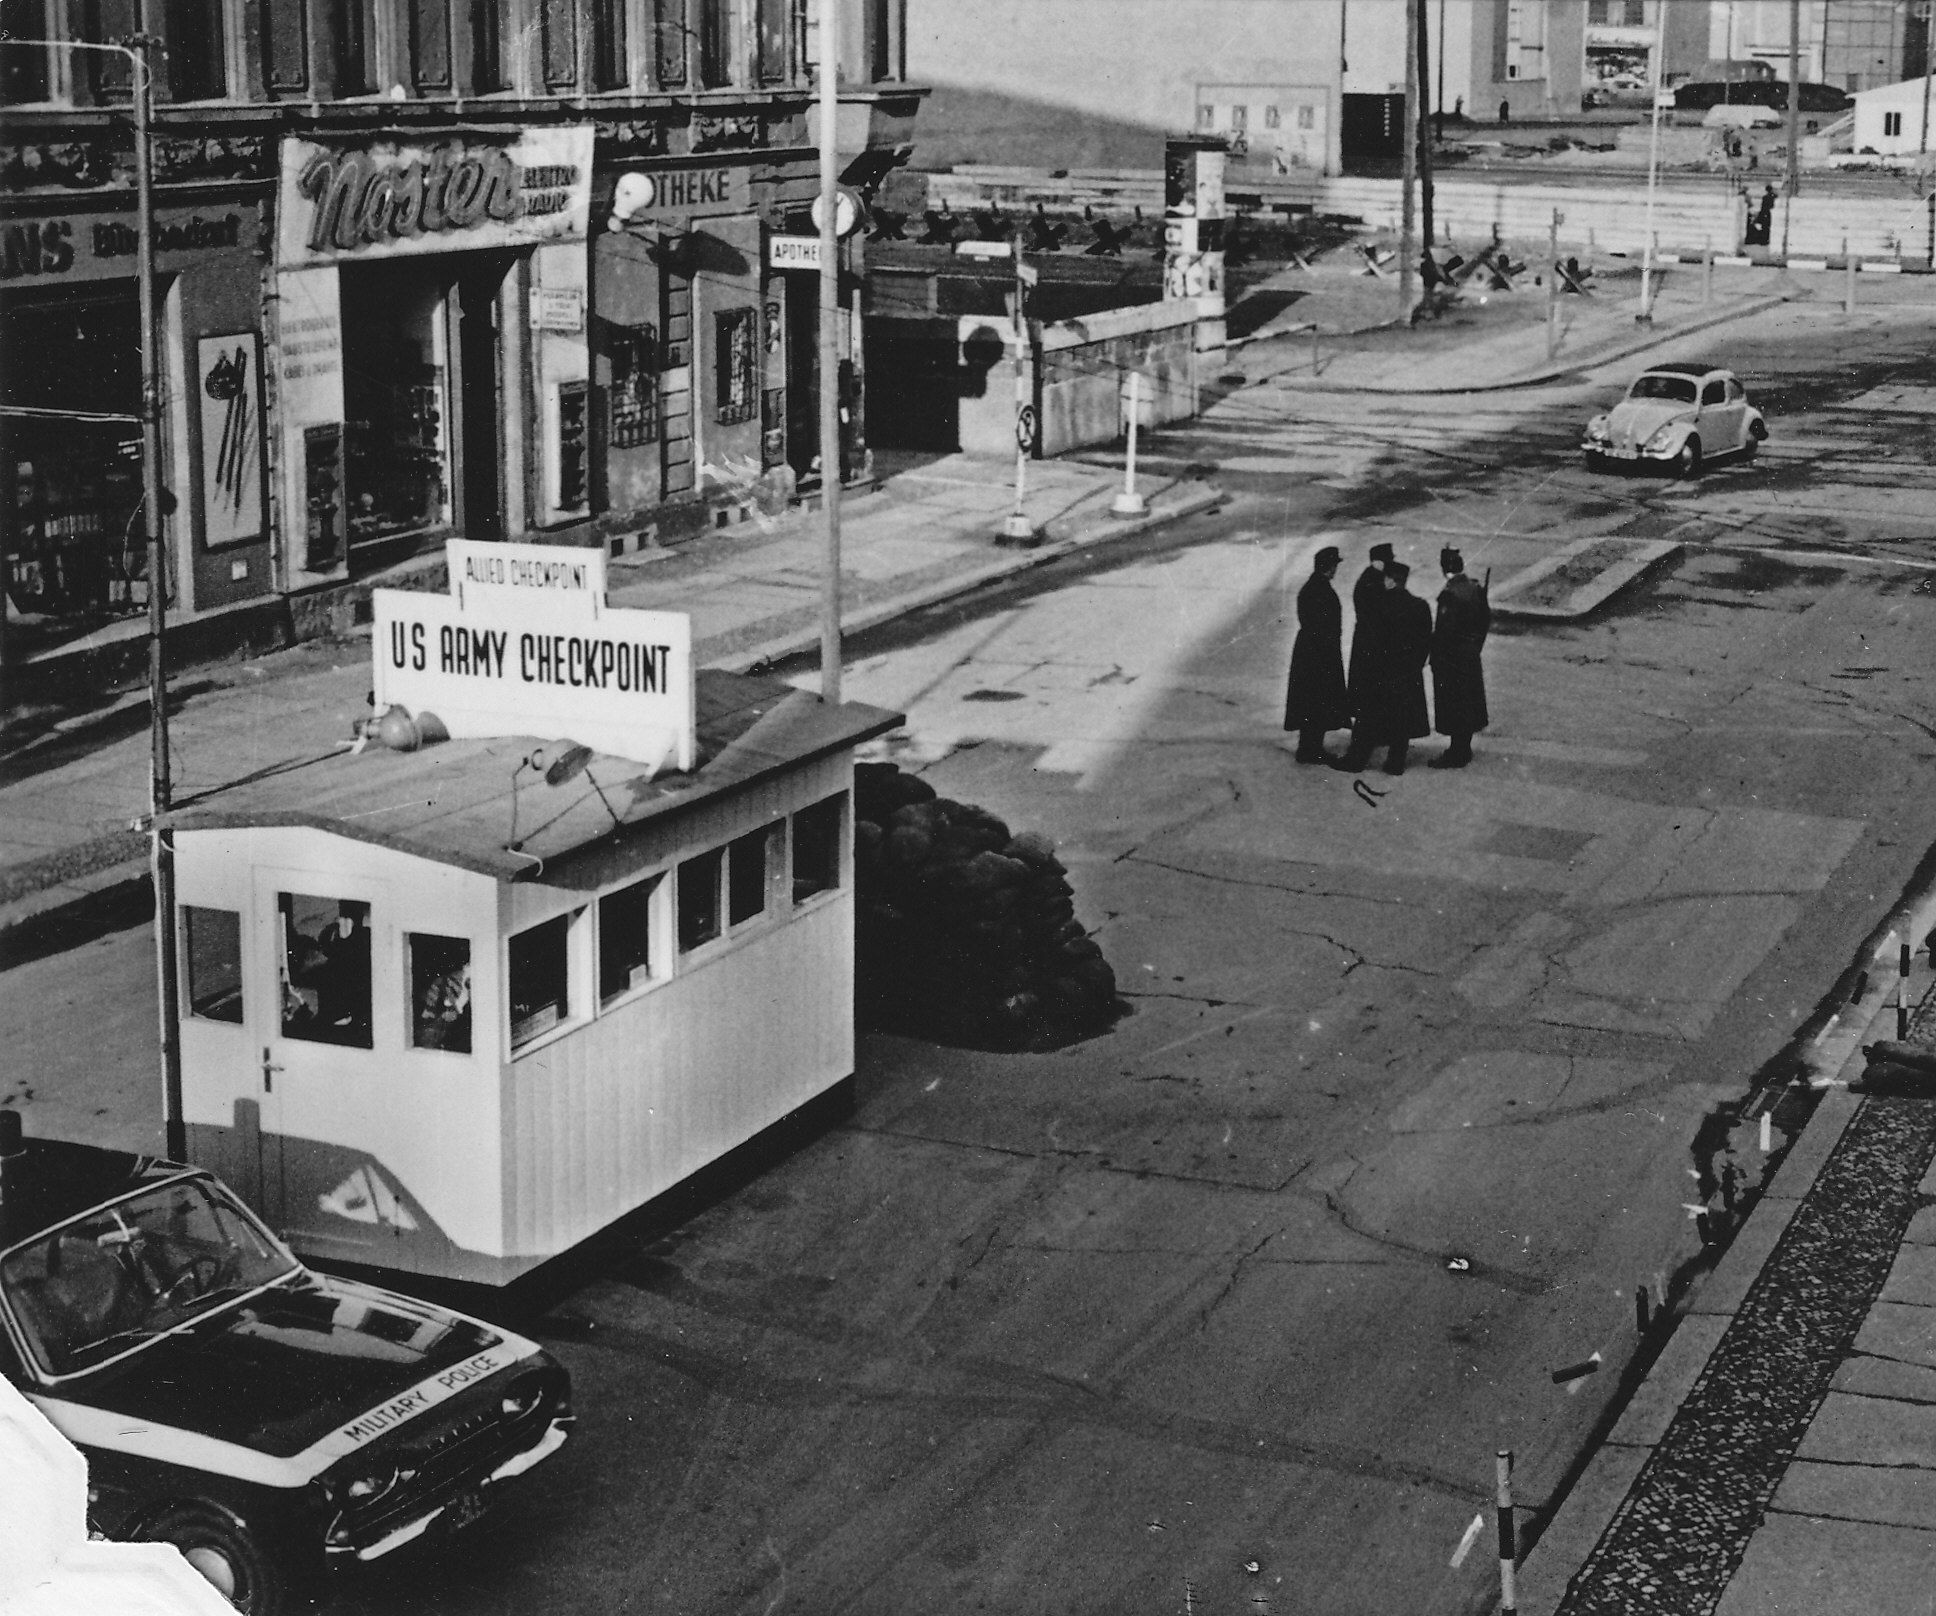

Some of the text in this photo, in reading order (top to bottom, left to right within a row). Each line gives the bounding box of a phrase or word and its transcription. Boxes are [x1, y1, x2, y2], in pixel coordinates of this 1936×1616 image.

[775, 244, 820, 261] APOTHE
[466, 556, 588, 590] ALLIED CHECKPOINT
[391, 621, 671, 695] US ARMY CHECKPOINT
[343, 1355, 499, 1442] MILITARY POLICE
